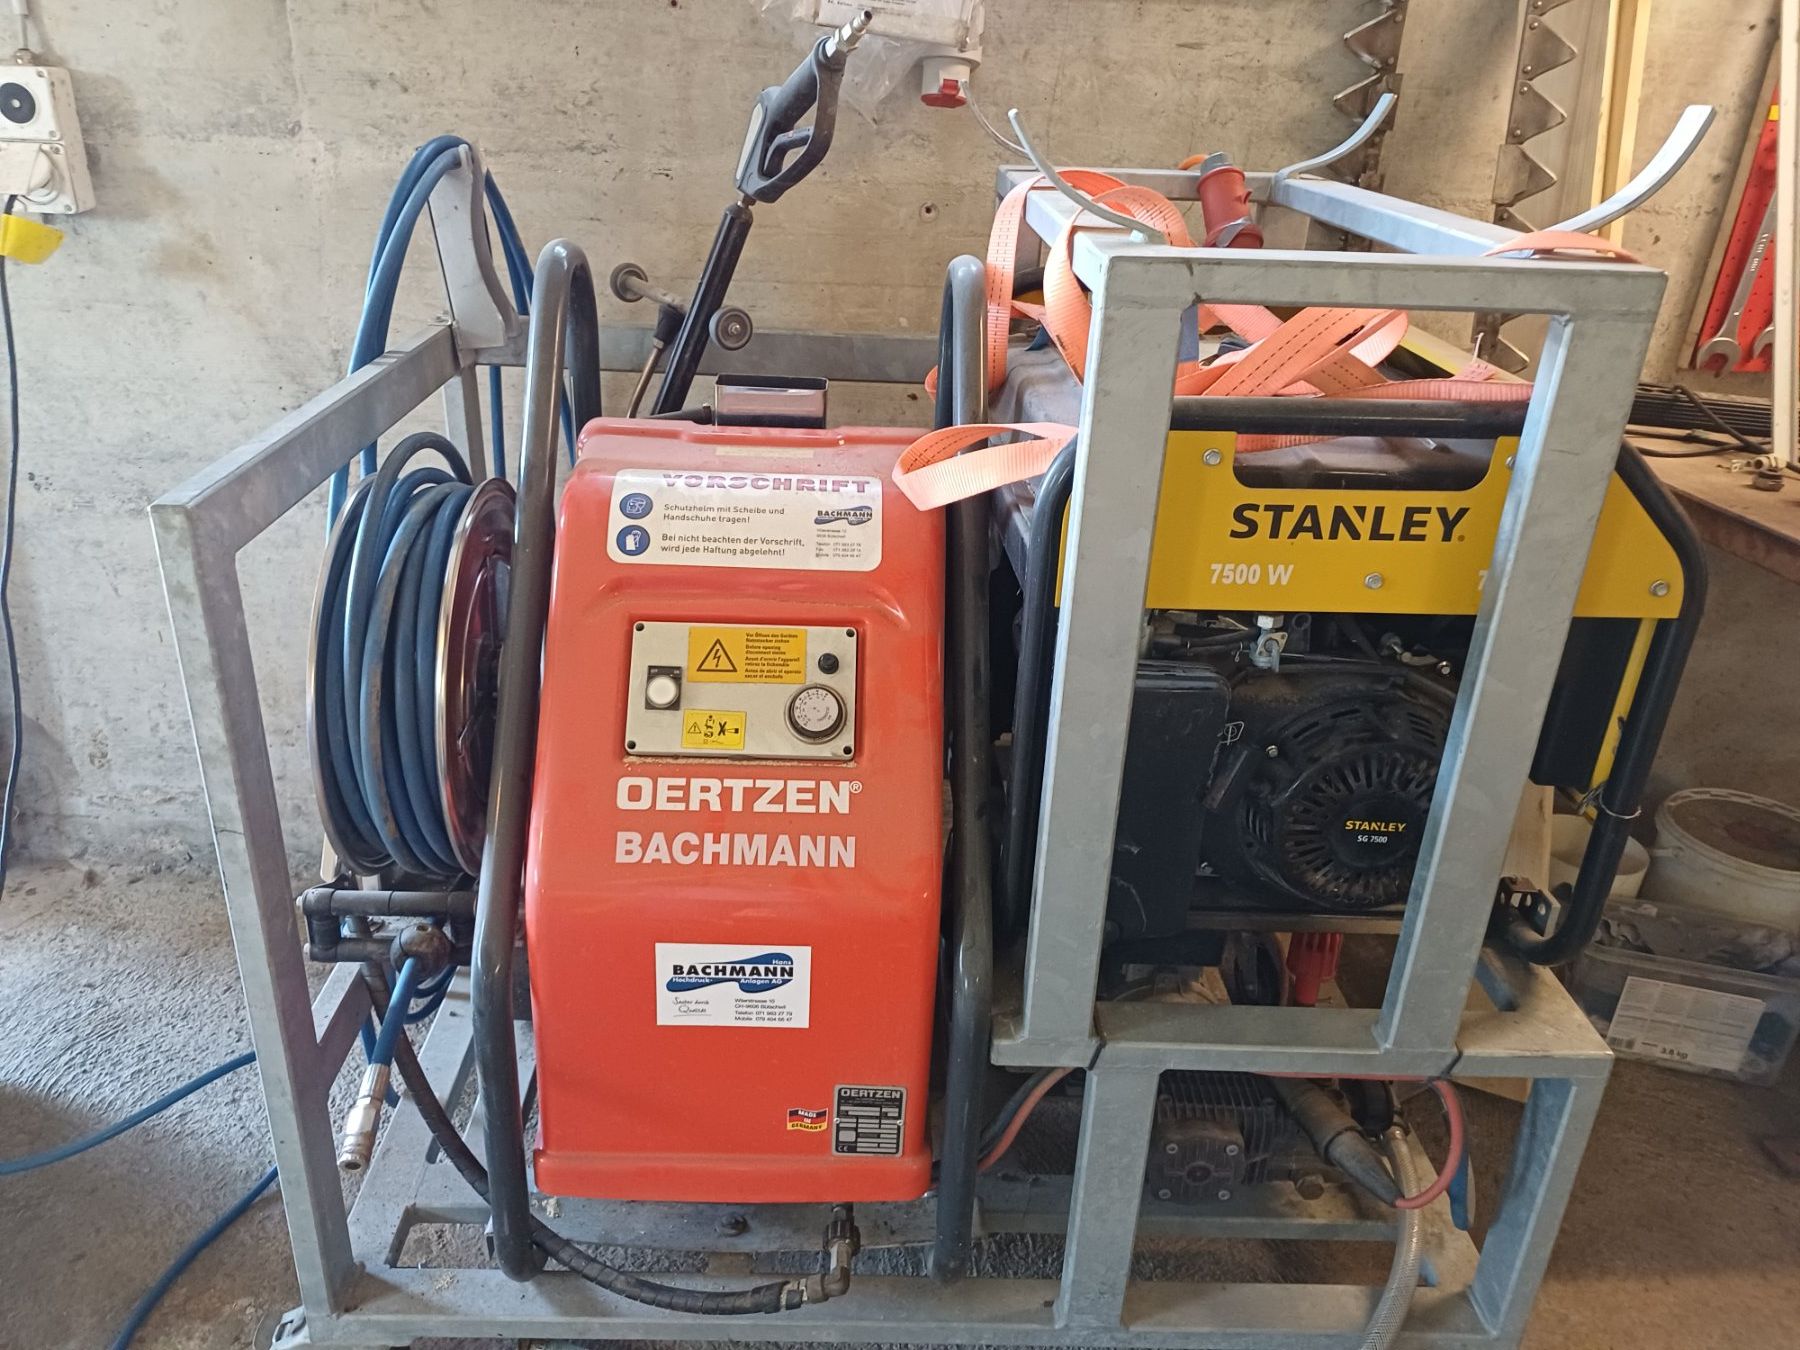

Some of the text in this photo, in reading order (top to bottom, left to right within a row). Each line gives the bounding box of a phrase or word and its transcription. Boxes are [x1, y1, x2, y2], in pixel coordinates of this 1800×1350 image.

[662, 474, 870, 493] VORSCHRIFT
[664, 503, 715, 512] Schutzhelm
[716, 505, 731, 513] mit
[732, 505, 767, 514] Scheibe
[817, 510, 872, 518] BACHMANN
[663, 513, 750, 524] Handschuhe tragen!
[1230, 503, 1470, 542] STANLEY
[661, 533, 676, 541] Bei
[678, 534, 700, 542] nicht
[701, 534, 742, 544] beachten
[743, 536, 759, 544] der
[681, 545, 701, 554] jede
[703, 546, 737, 556] Haftung
[739, 547, 785, 556] abgelehnt!
[1210, 563, 1295, 586] 7500 W
[1344, 820, 1407, 832] STANLEY
[1357, 834, 1388, 844] SG 7500
[615, 831, 856, 867] BACHMANN
[672, 964, 794, 977] BACHMANN
[840, 1088, 901, 1099] OERTZEN
